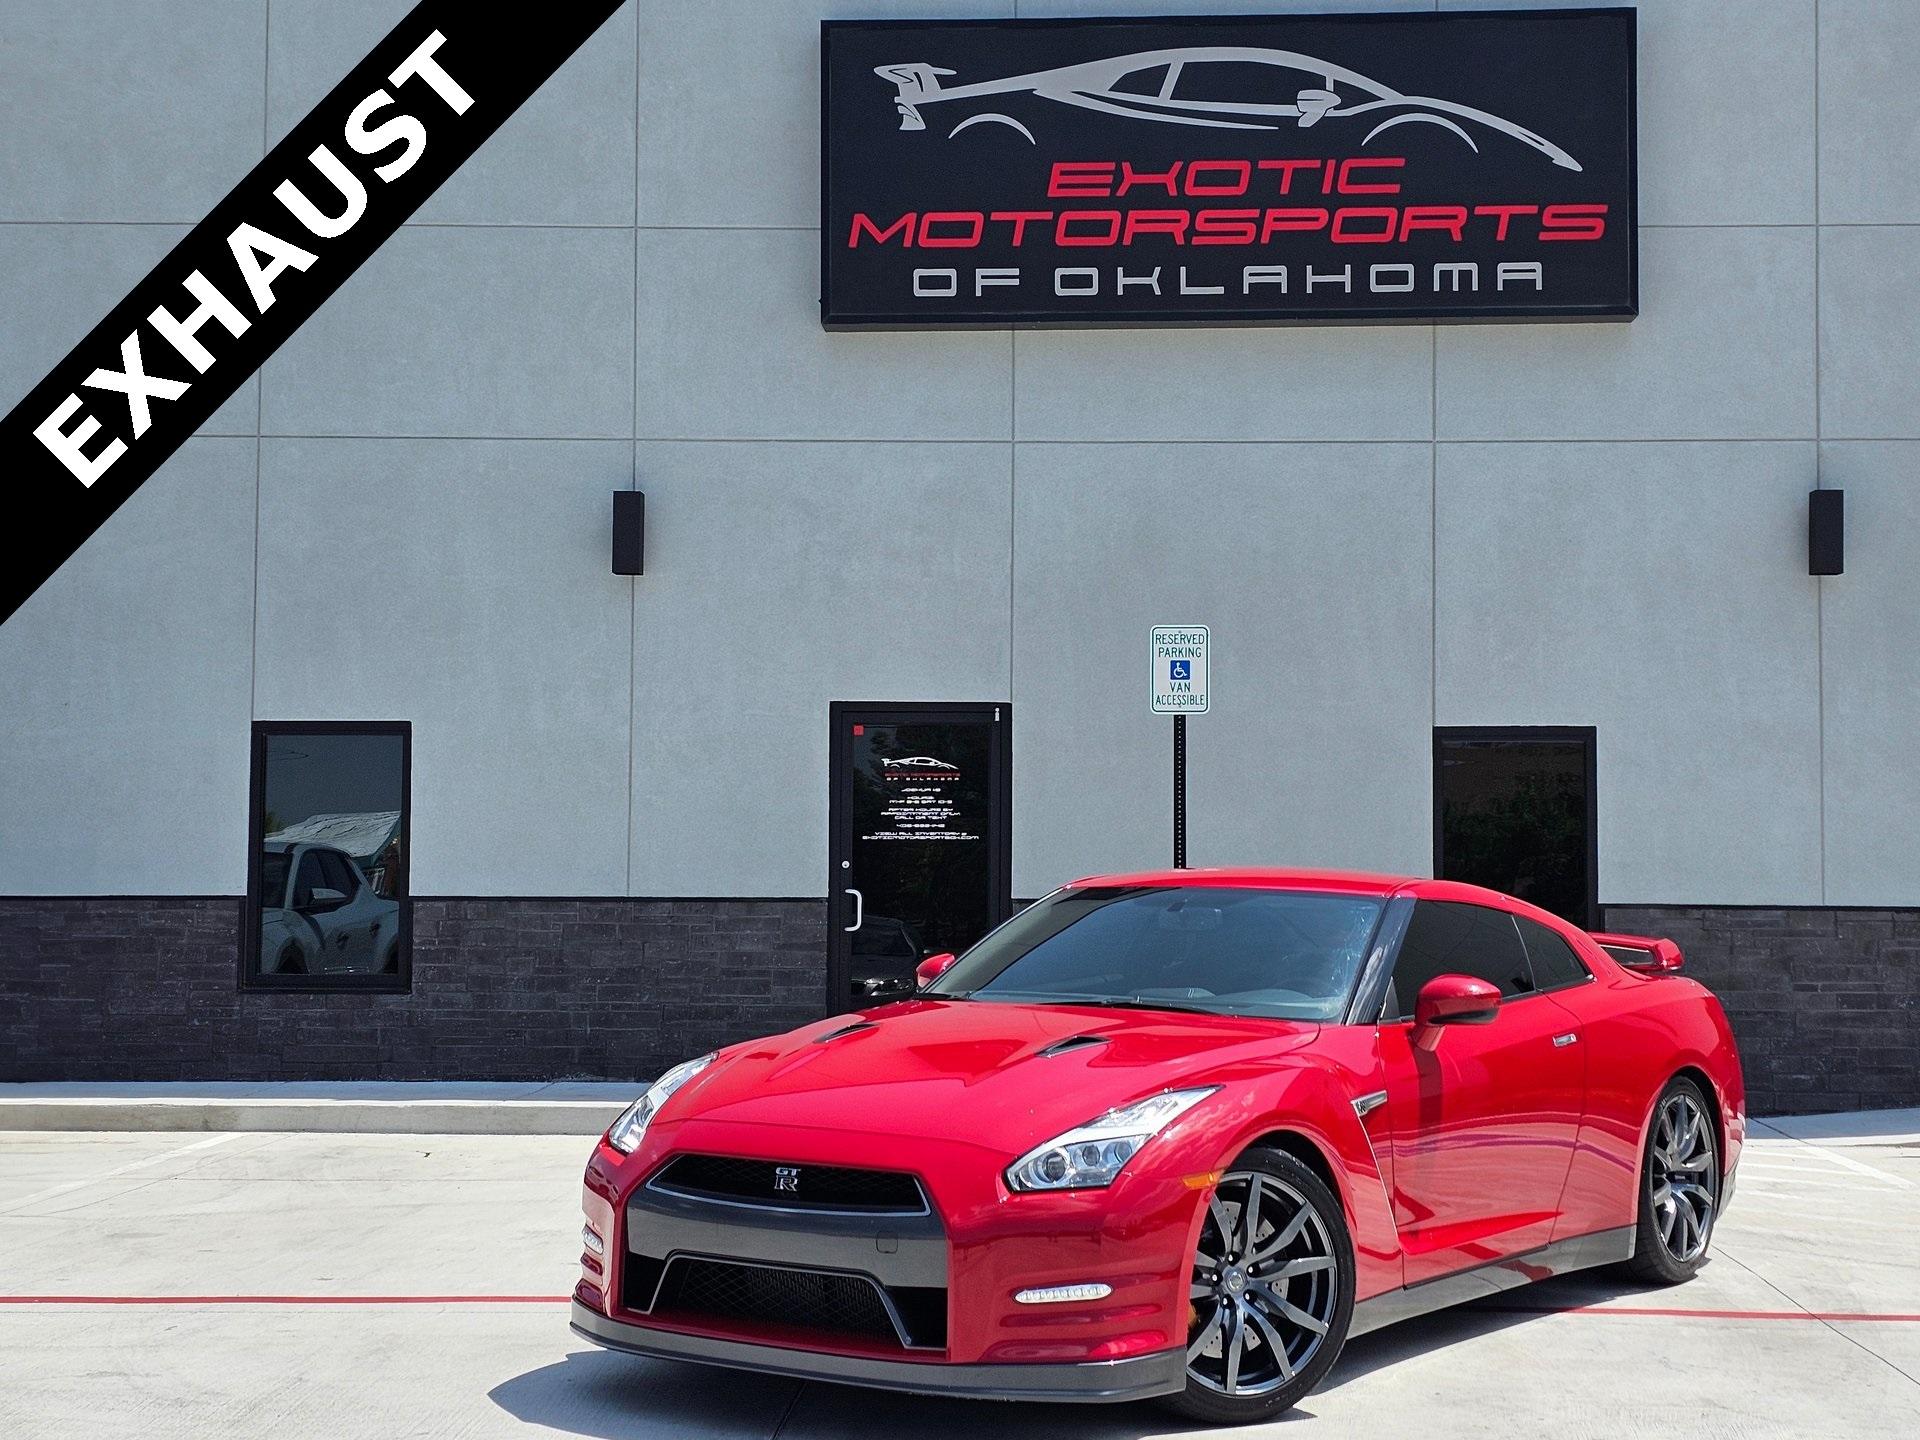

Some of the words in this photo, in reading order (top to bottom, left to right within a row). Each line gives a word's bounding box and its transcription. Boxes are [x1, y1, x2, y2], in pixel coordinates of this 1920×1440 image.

[1048, 157, 1405, 198] EXOTIC
[849, 204, 1608, 249] MOTORSPORTS
[912, 268, 1020, 297] OF
[1054, 261, 1543, 297] OKLAHOMA
[1156, 634, 1204, 644] RESERVED
[1158, 647, 1202, 657] PARKING
[1170, 682, 1190, 692] VAN
[1156, 695, 1204, 705] ACCESSIBLE
[774, 1175, 798, 1192] R
